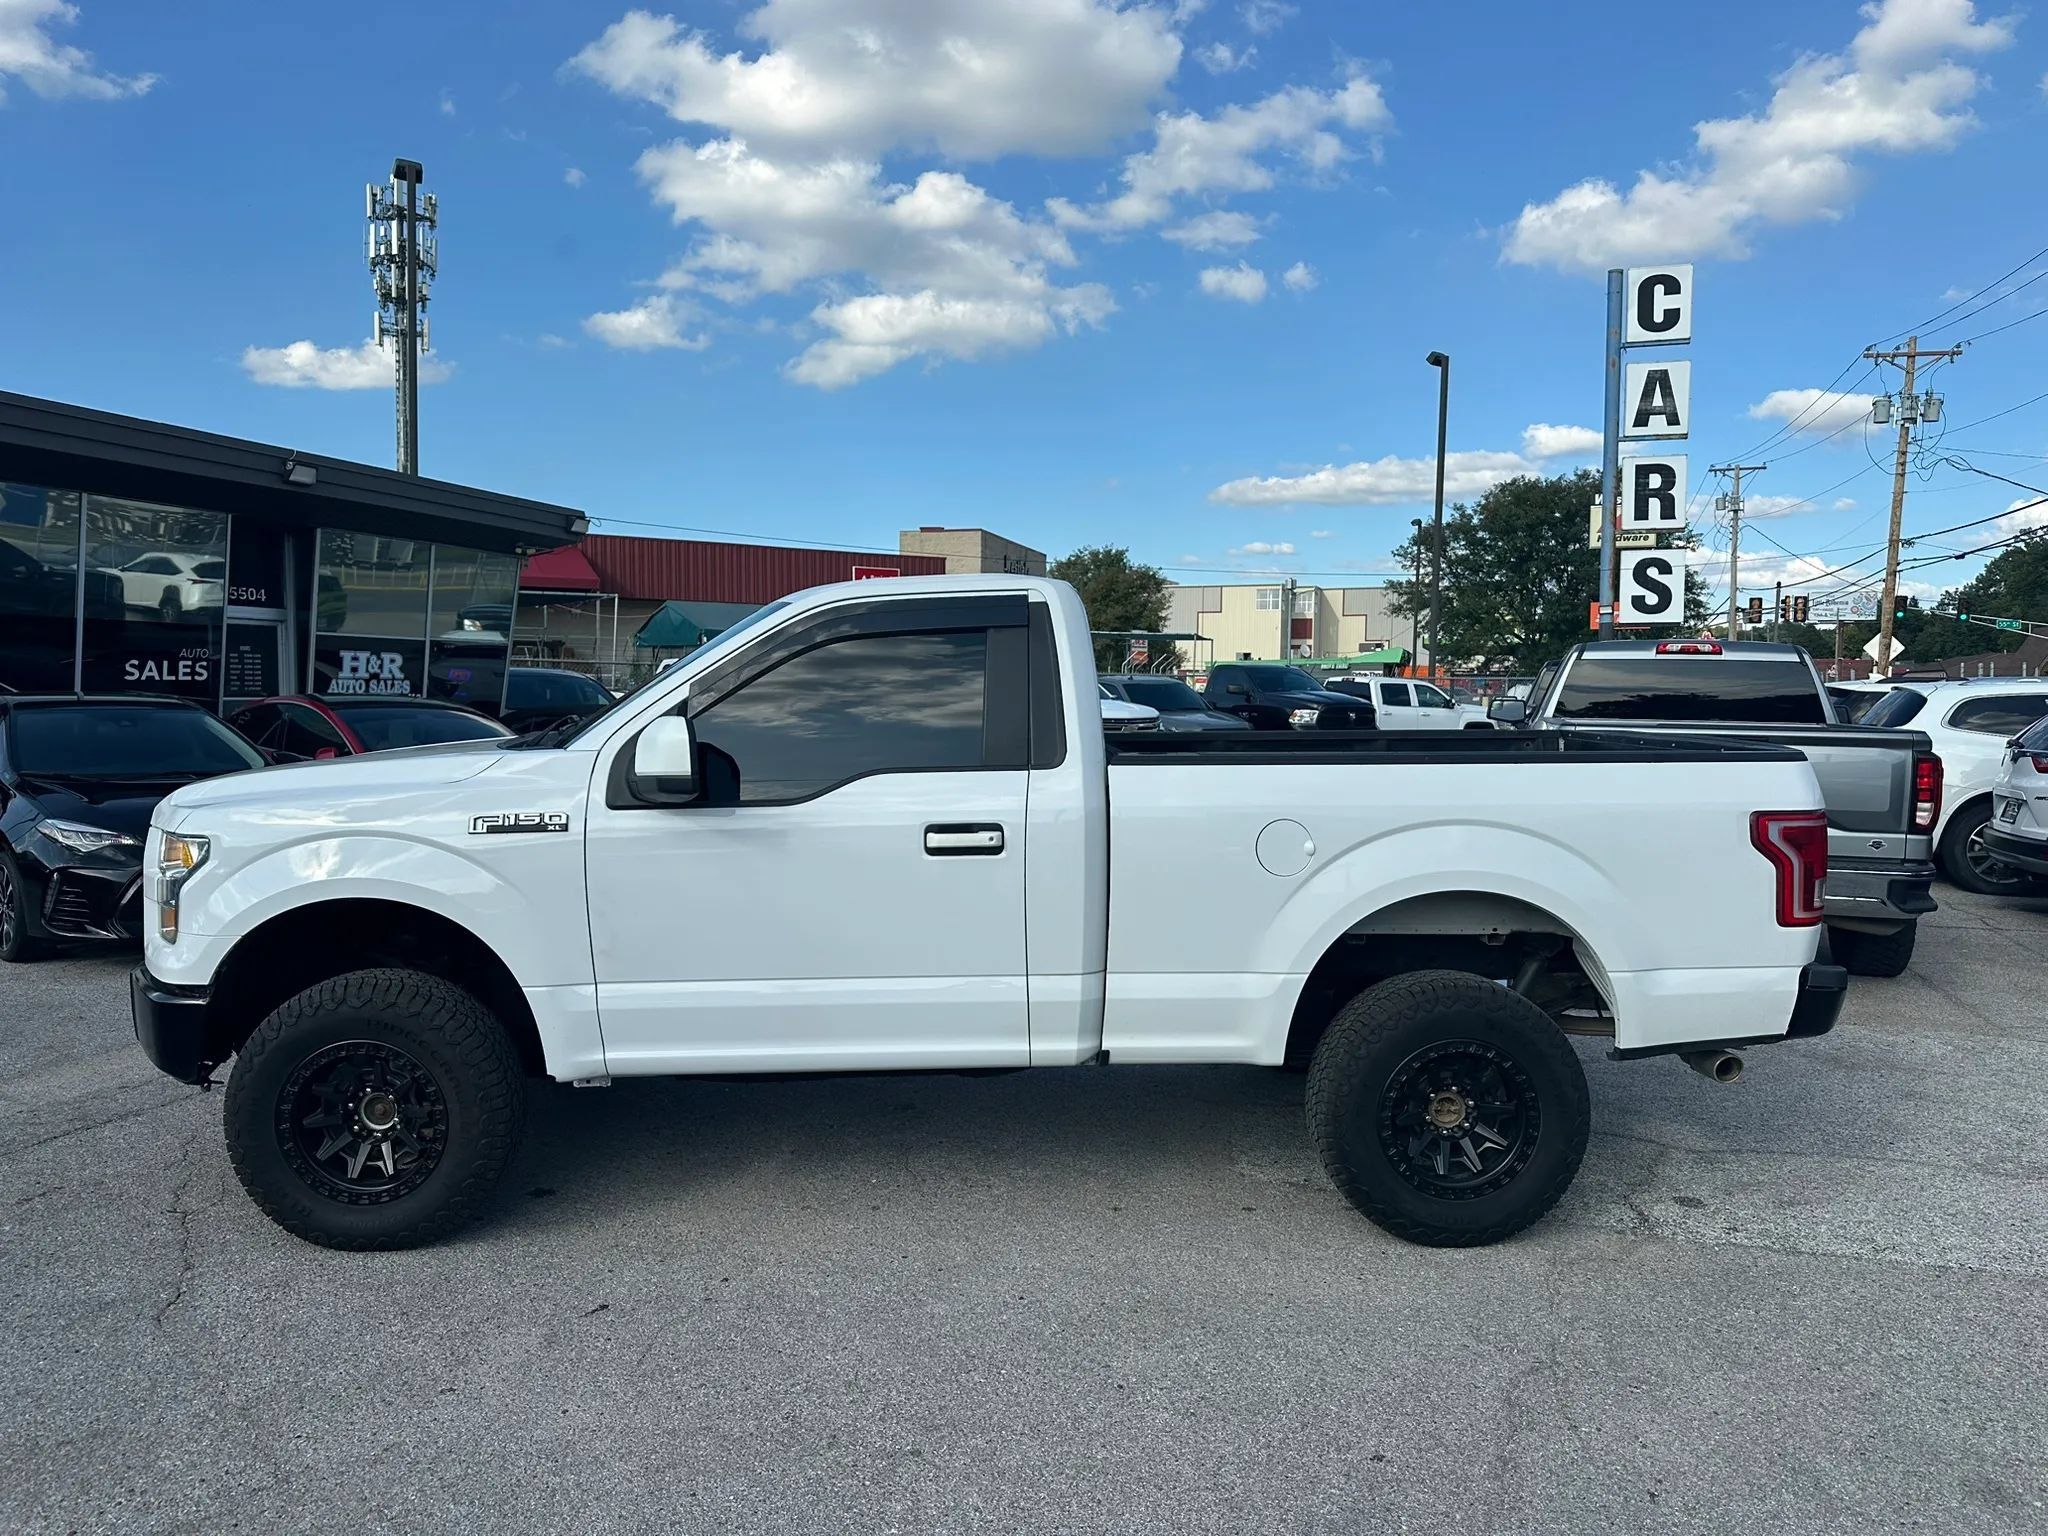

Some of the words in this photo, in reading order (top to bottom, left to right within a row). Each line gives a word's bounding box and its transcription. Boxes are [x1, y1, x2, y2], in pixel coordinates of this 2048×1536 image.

[1631, 274, 1681, 615] CARS
[1597, 534, 1650, 543] dware
[229, 586, 266, 602] 5504
[179, 648, 209, 659] AUTO
[123, 659, 208, 681] SALES
[338, 650, 405, 679] H&R
[327, 678, 366, 694] AUTO
[368, 679, 411, 695] SALES
